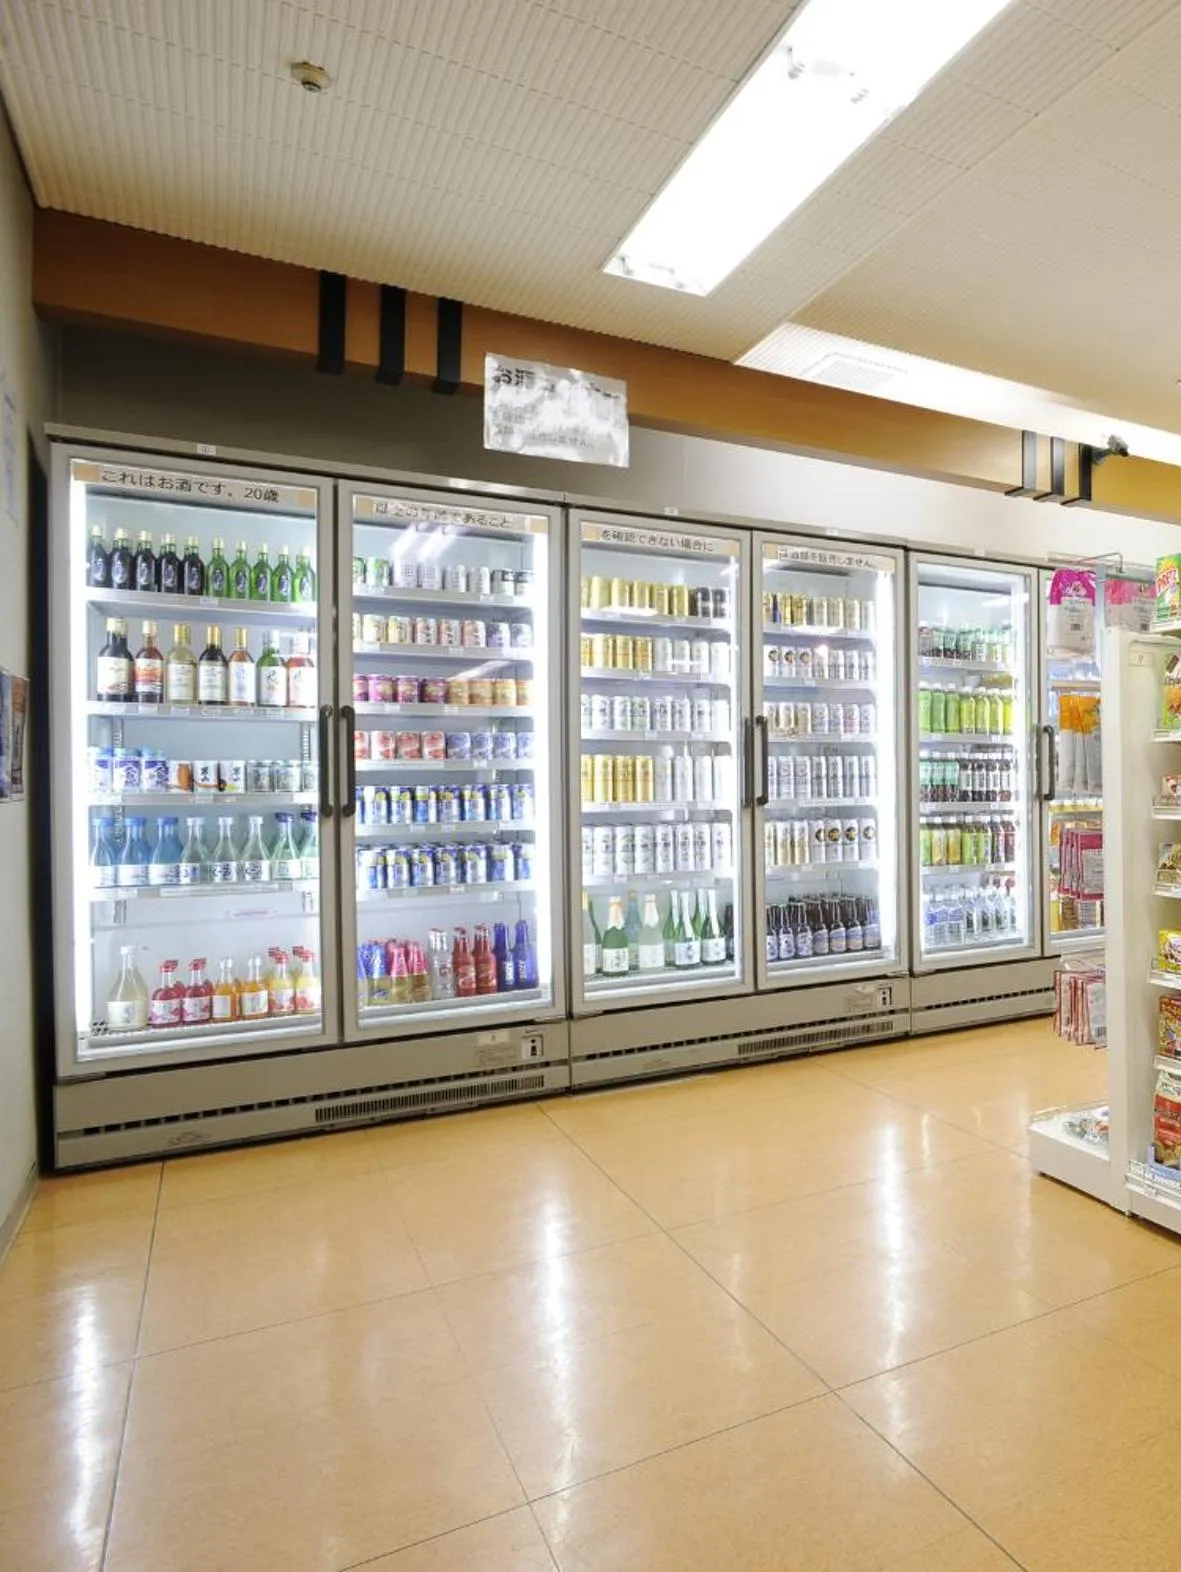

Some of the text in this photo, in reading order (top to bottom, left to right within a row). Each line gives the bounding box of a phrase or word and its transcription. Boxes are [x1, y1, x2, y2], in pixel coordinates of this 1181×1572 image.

[102, 470, 280, 503] これはお酒です。20歳
